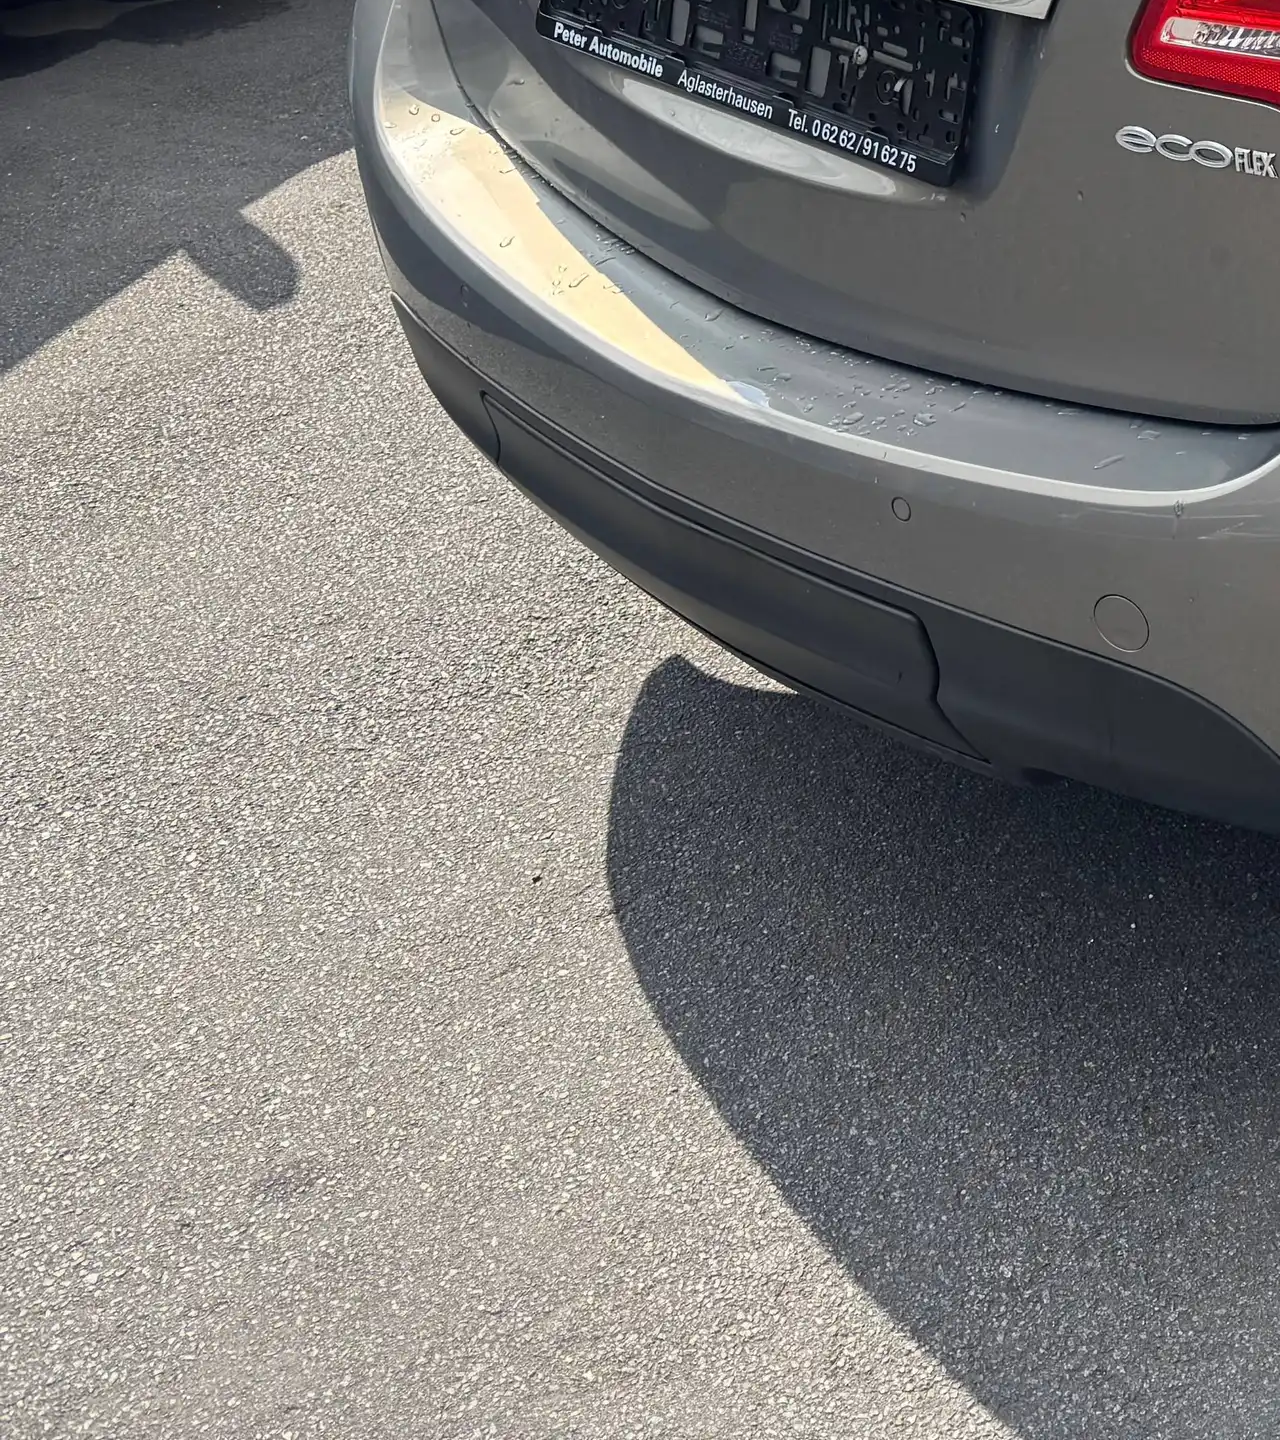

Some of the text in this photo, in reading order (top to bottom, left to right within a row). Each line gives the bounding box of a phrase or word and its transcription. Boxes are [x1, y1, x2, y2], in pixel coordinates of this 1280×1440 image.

[554, 22, 587, 48] Peter
[589, 36, 663, 77] Automobile
[677, 69, 773, 119] Aglasterhausen
[788, 109, 808, 133] Tel.
